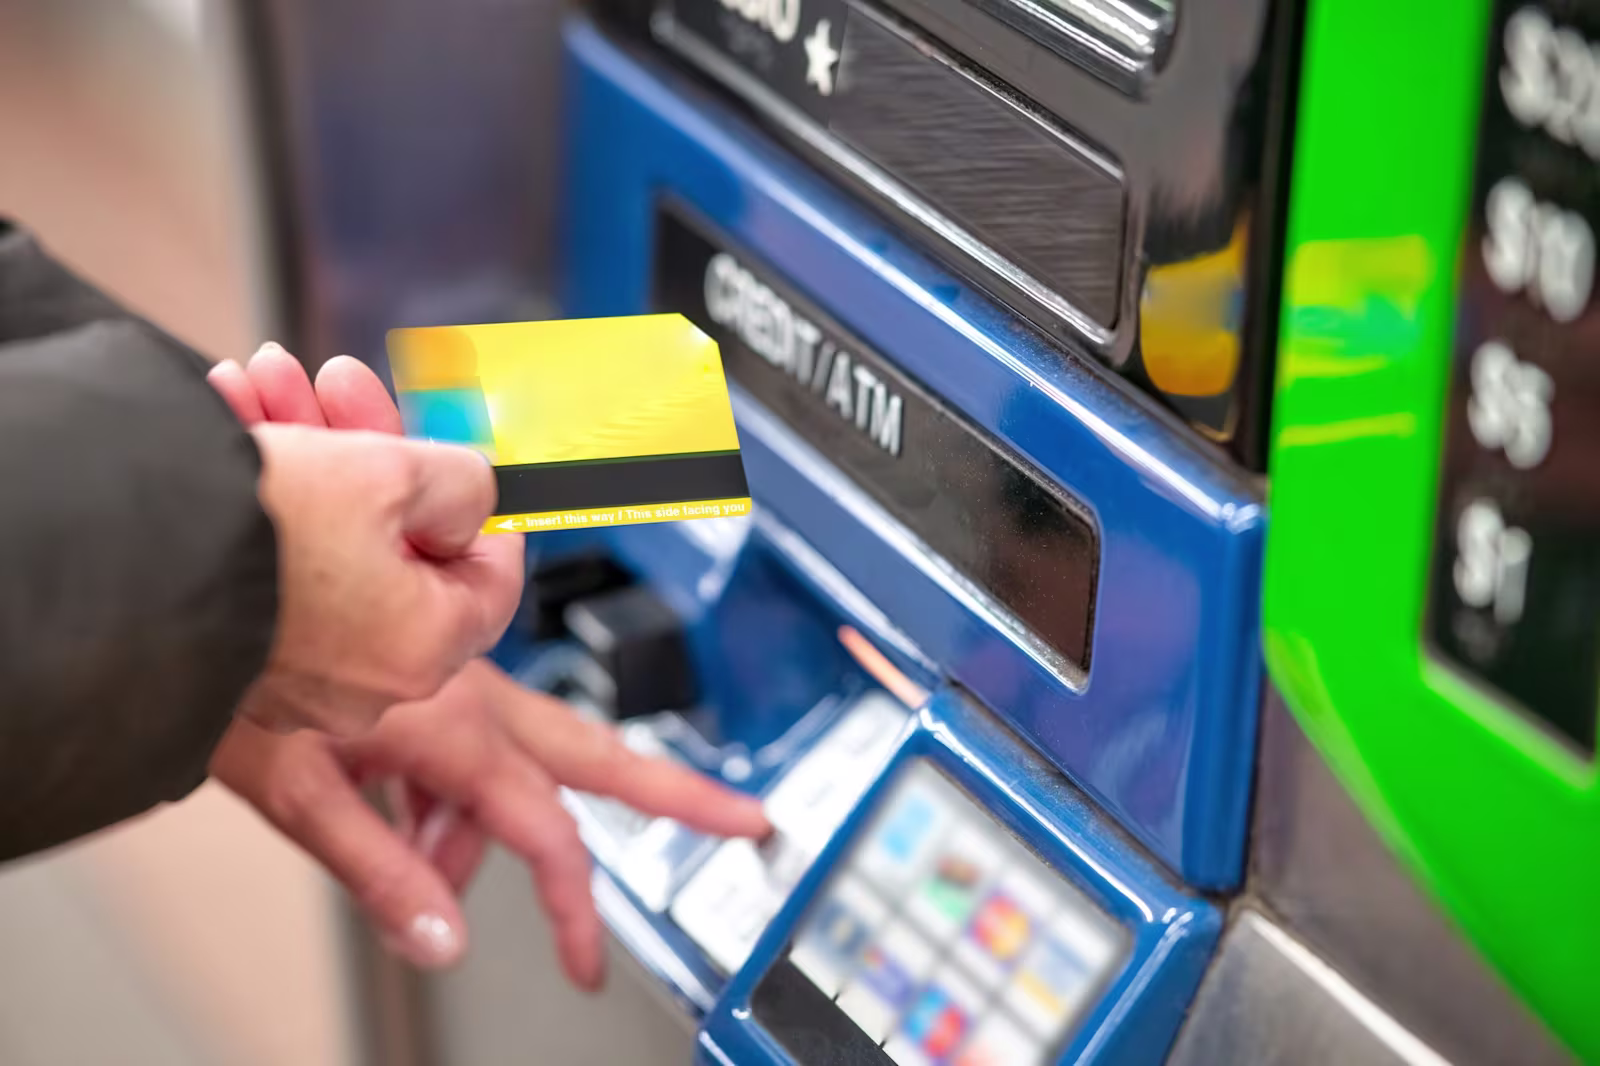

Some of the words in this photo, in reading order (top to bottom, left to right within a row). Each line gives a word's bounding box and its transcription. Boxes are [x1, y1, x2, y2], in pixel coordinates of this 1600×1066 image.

[703, 252, 903, 456] CREDIT/ATM
[564, 513, 588, 525] this
[591, 512, 615, 525] way
[626, 508, 652, 520] This
[655, 505, 680, 518] side
[682, 504, 720, 518] facing
[722, 503, 745, 515] you
